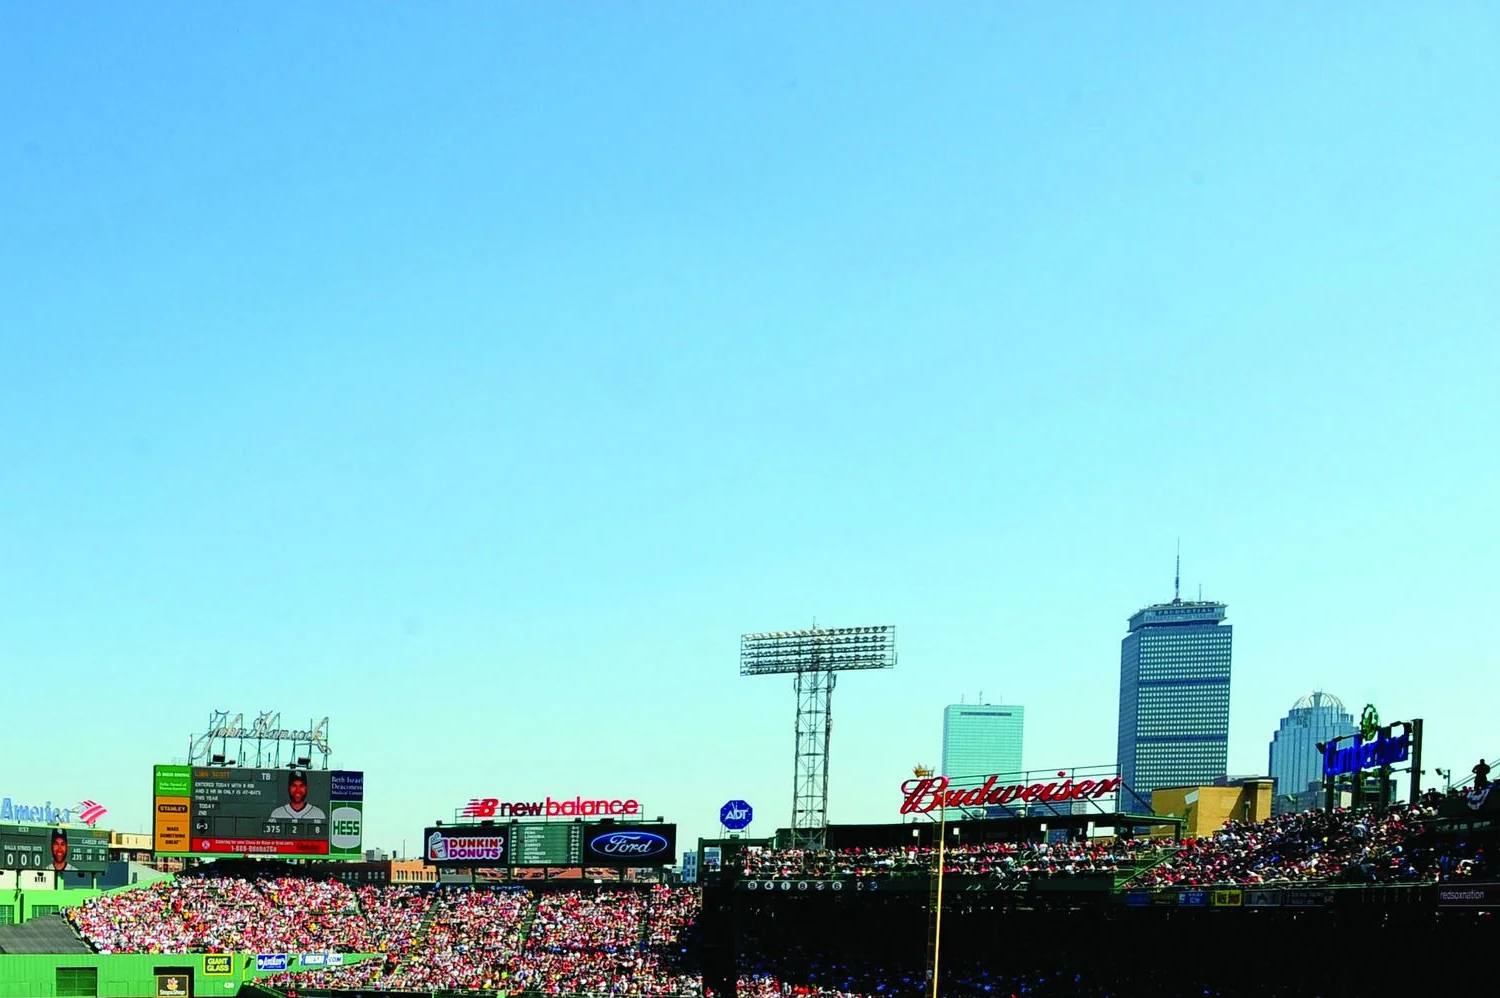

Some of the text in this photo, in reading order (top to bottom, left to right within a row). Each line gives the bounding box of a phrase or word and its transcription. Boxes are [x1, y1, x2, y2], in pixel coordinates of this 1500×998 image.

[192, 709, 332, 760] John Hancock
[346, 776, 363, 784] Israel
[332, 783, 363, 791] Deaconess
[900, 771, 1123, 814] Budweiser
[1, 798, 70, 824] America
[500, 796, 639, 816] new balance
[725, 809, 748, 820] ADT
[333, 821, 360, 836] HESS
[450, 838, 502, 848] DUNKIN'
[605, 835, 652, 853] Ford
[449, 848, 500, 859] DONUTS
[7, 854, 41, 866] 0 0 0
[207, 957, 229, 965] GIANT
[207, 964, 229, 972] GLASS
